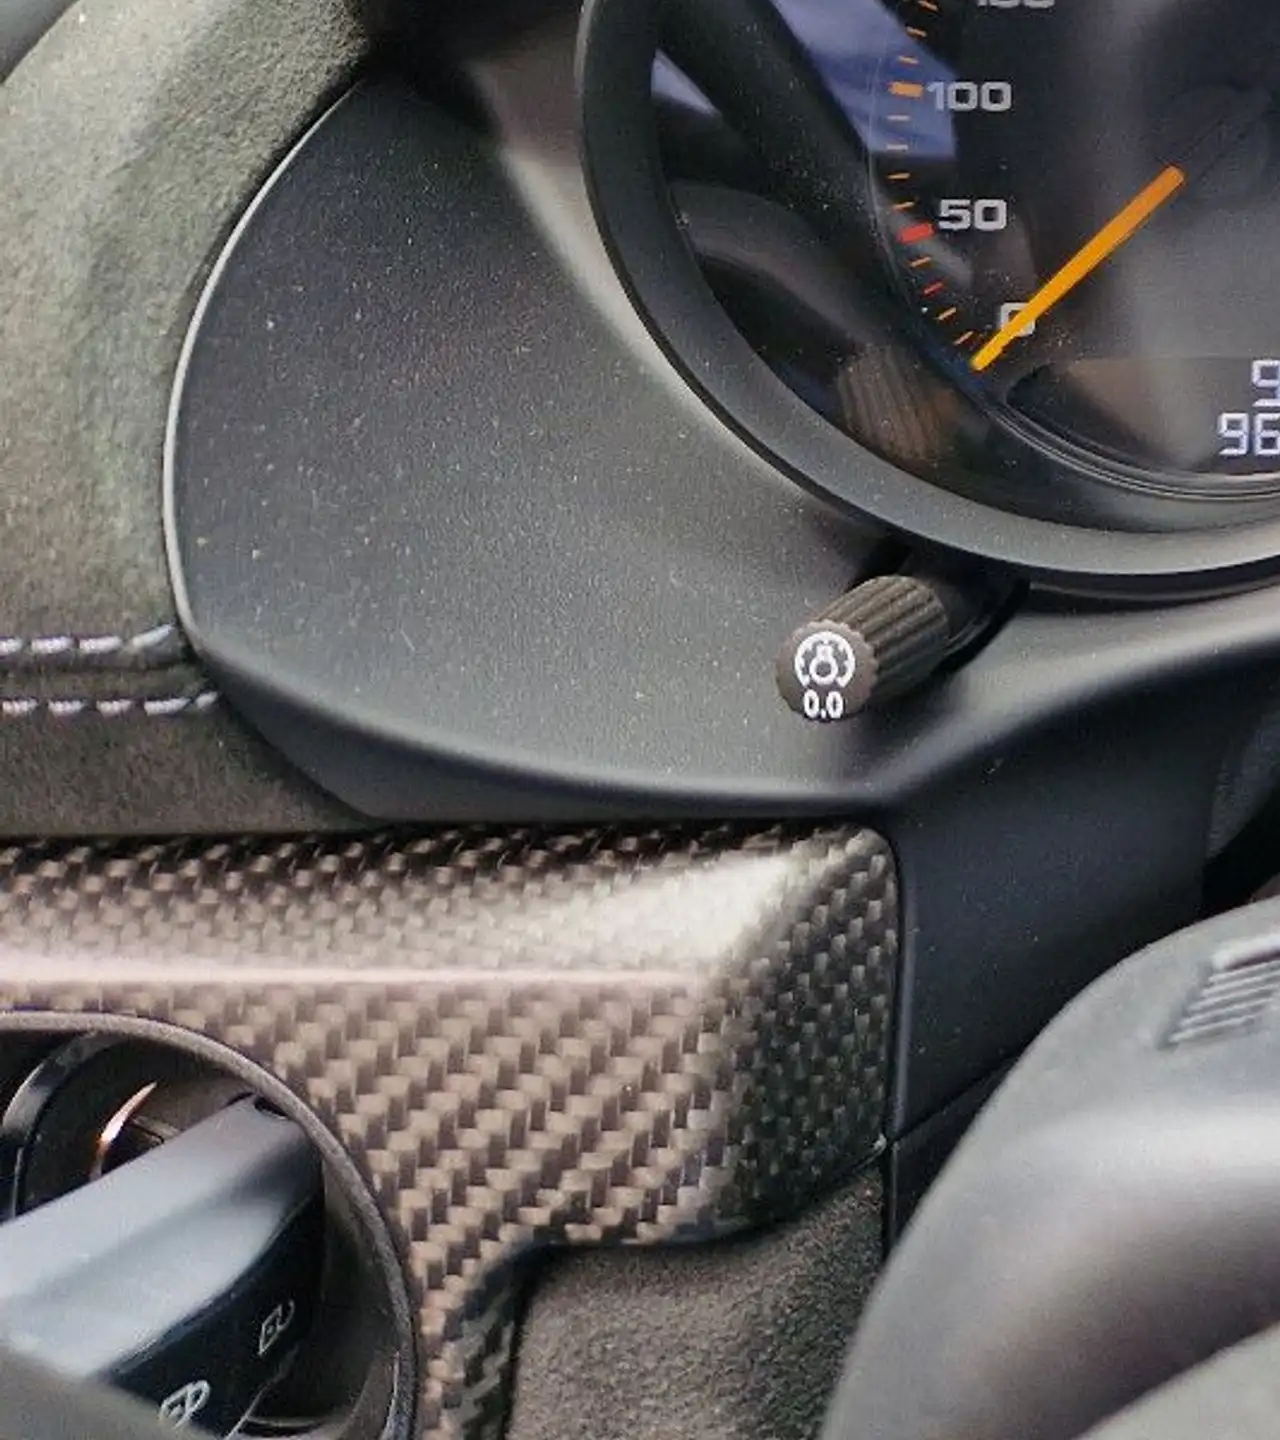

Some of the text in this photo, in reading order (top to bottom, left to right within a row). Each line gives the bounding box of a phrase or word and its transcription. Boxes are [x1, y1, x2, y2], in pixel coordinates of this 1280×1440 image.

[926, 81, 1012, 111] 100
[938, 199, 1007, 231] 50
[803, 689, 844, 719] 0.0
